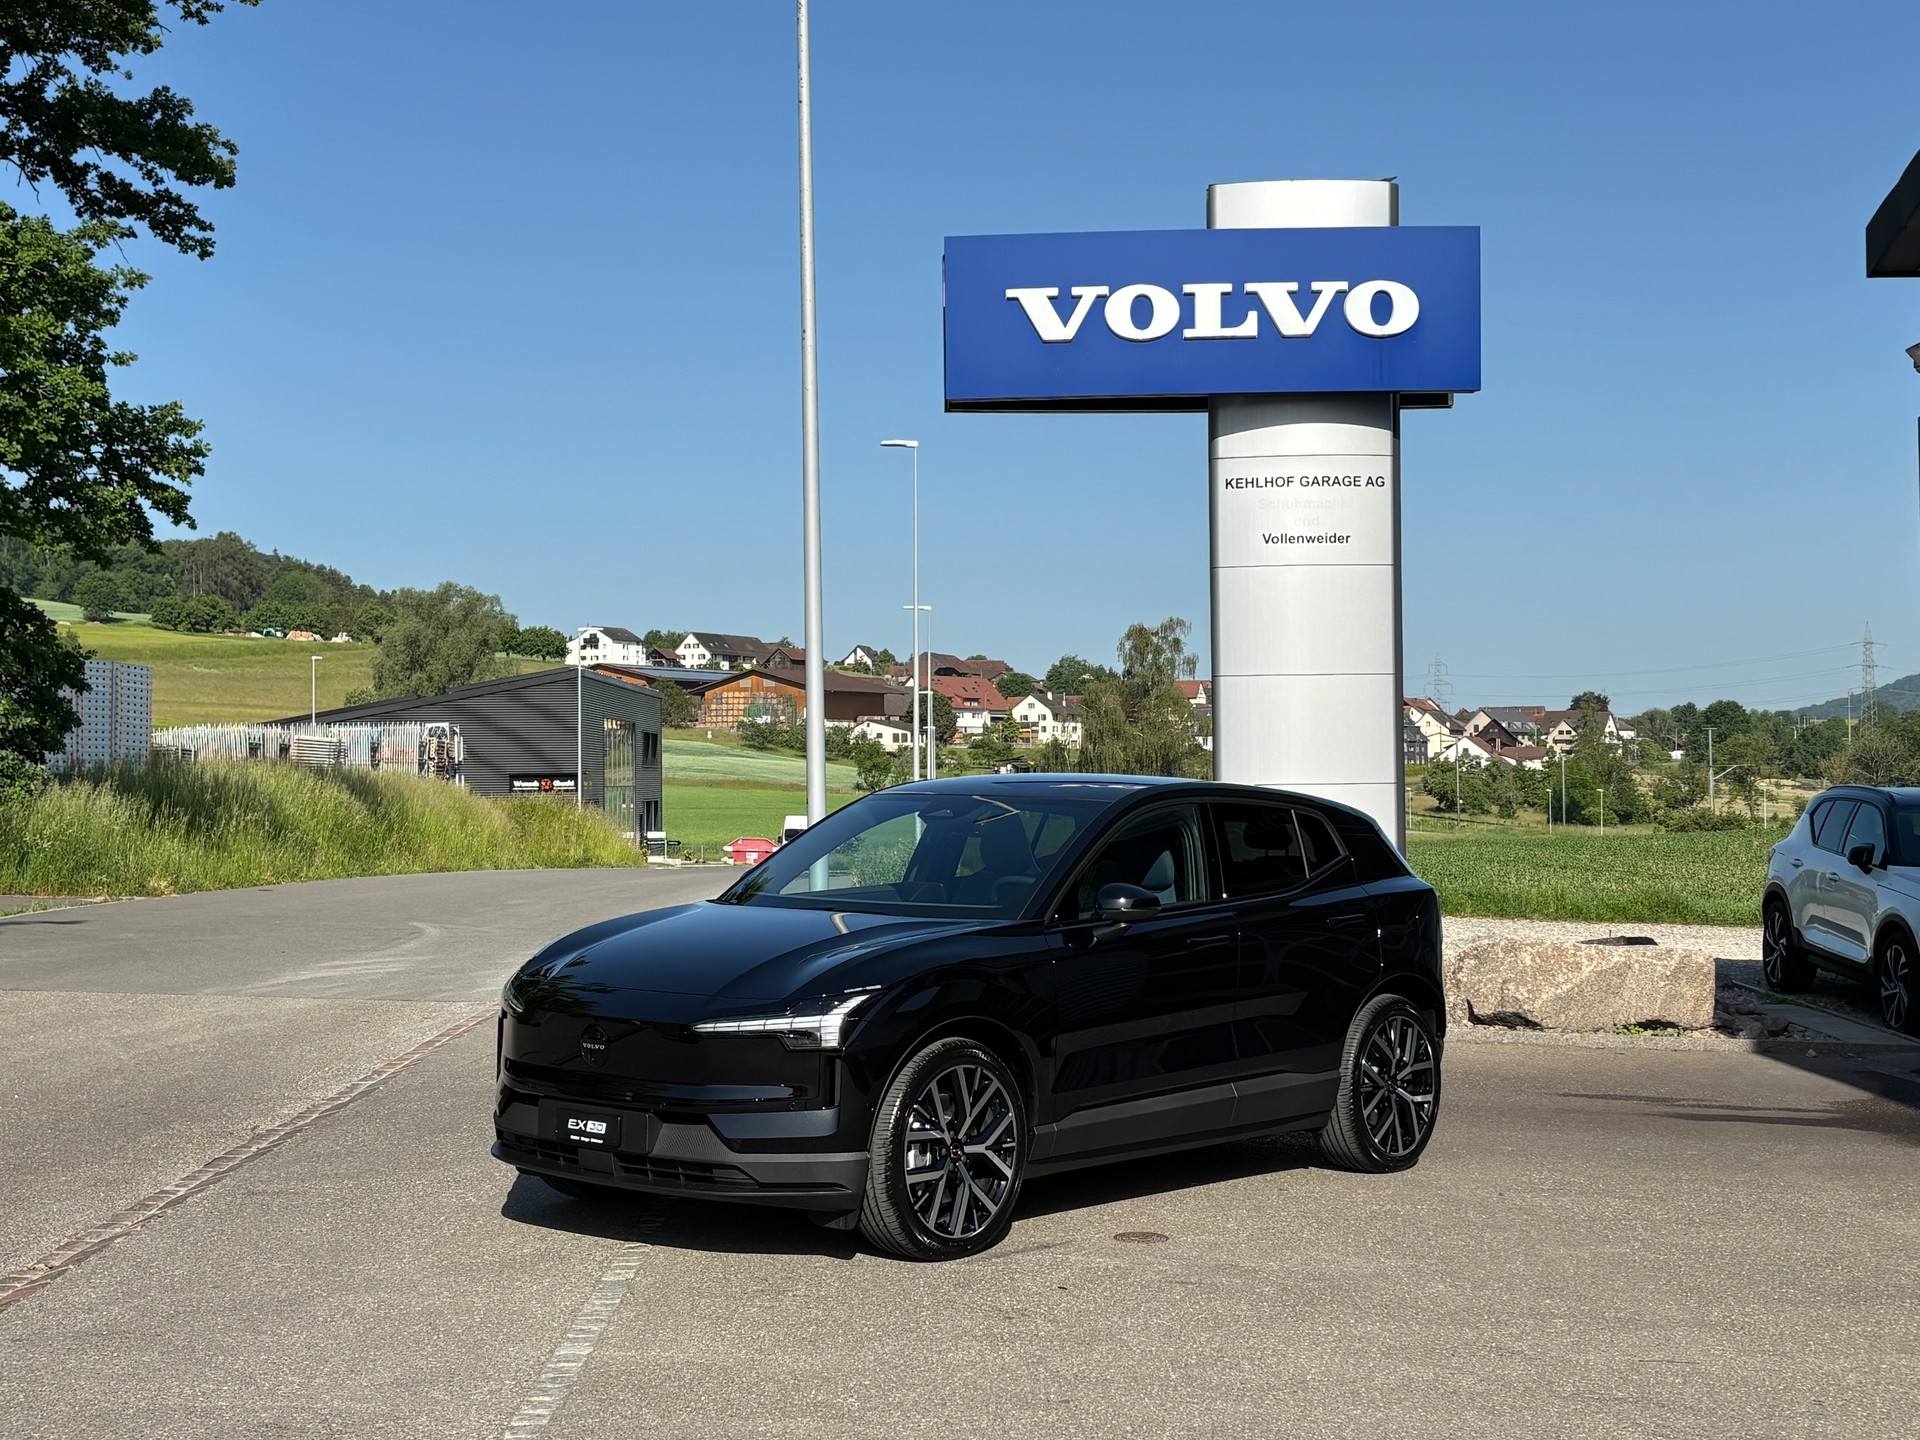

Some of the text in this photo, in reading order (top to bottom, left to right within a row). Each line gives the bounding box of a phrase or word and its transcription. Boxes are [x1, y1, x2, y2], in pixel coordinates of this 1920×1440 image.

[1005, 279, 1420, 343] VOLVO
[1225, 475, 1386, 490] KEHLHOF GARAGE AG
[1262, 532, 1351, 545] Vollenweider
[582, 1042, 606, 1050] VOLVO
